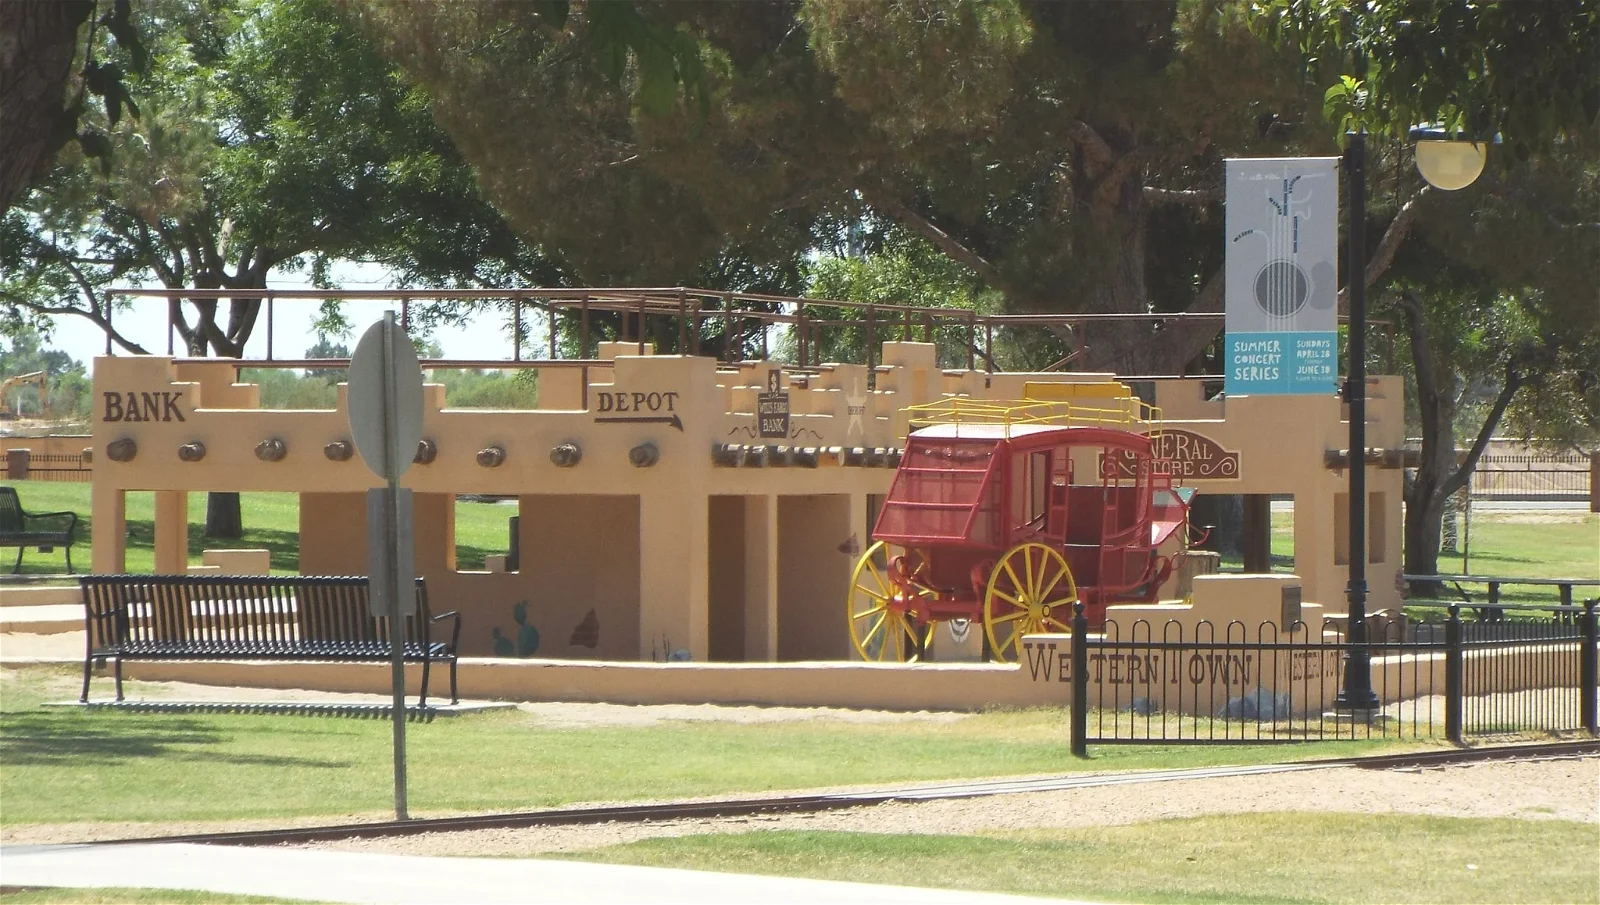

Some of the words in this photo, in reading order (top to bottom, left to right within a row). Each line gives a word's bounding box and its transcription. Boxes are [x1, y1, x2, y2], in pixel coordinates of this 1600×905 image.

[1234, 341, 1281, 352] SUMMER
[1296, 340, 1331, 348] SUNDAYS
[1234, 354, 1281, 365] CONCERT
[1296, 349, 1319, 358] APRIL
[1234, 366, 1279, 381] SERIES
[1296, 365, 1319, 375] JUNE
[1320, 365, 1331, 374] 30
[102, 391, 186, 422] BANK
[596, 391, 680, 412] DEPOT
[762, 418, 785, 432] BANK
[1124, 433, 1213, 460] GNERAL
[1141, 459, 1195, 476] STORE
[1023, 643, 1160, 684] WETERN
